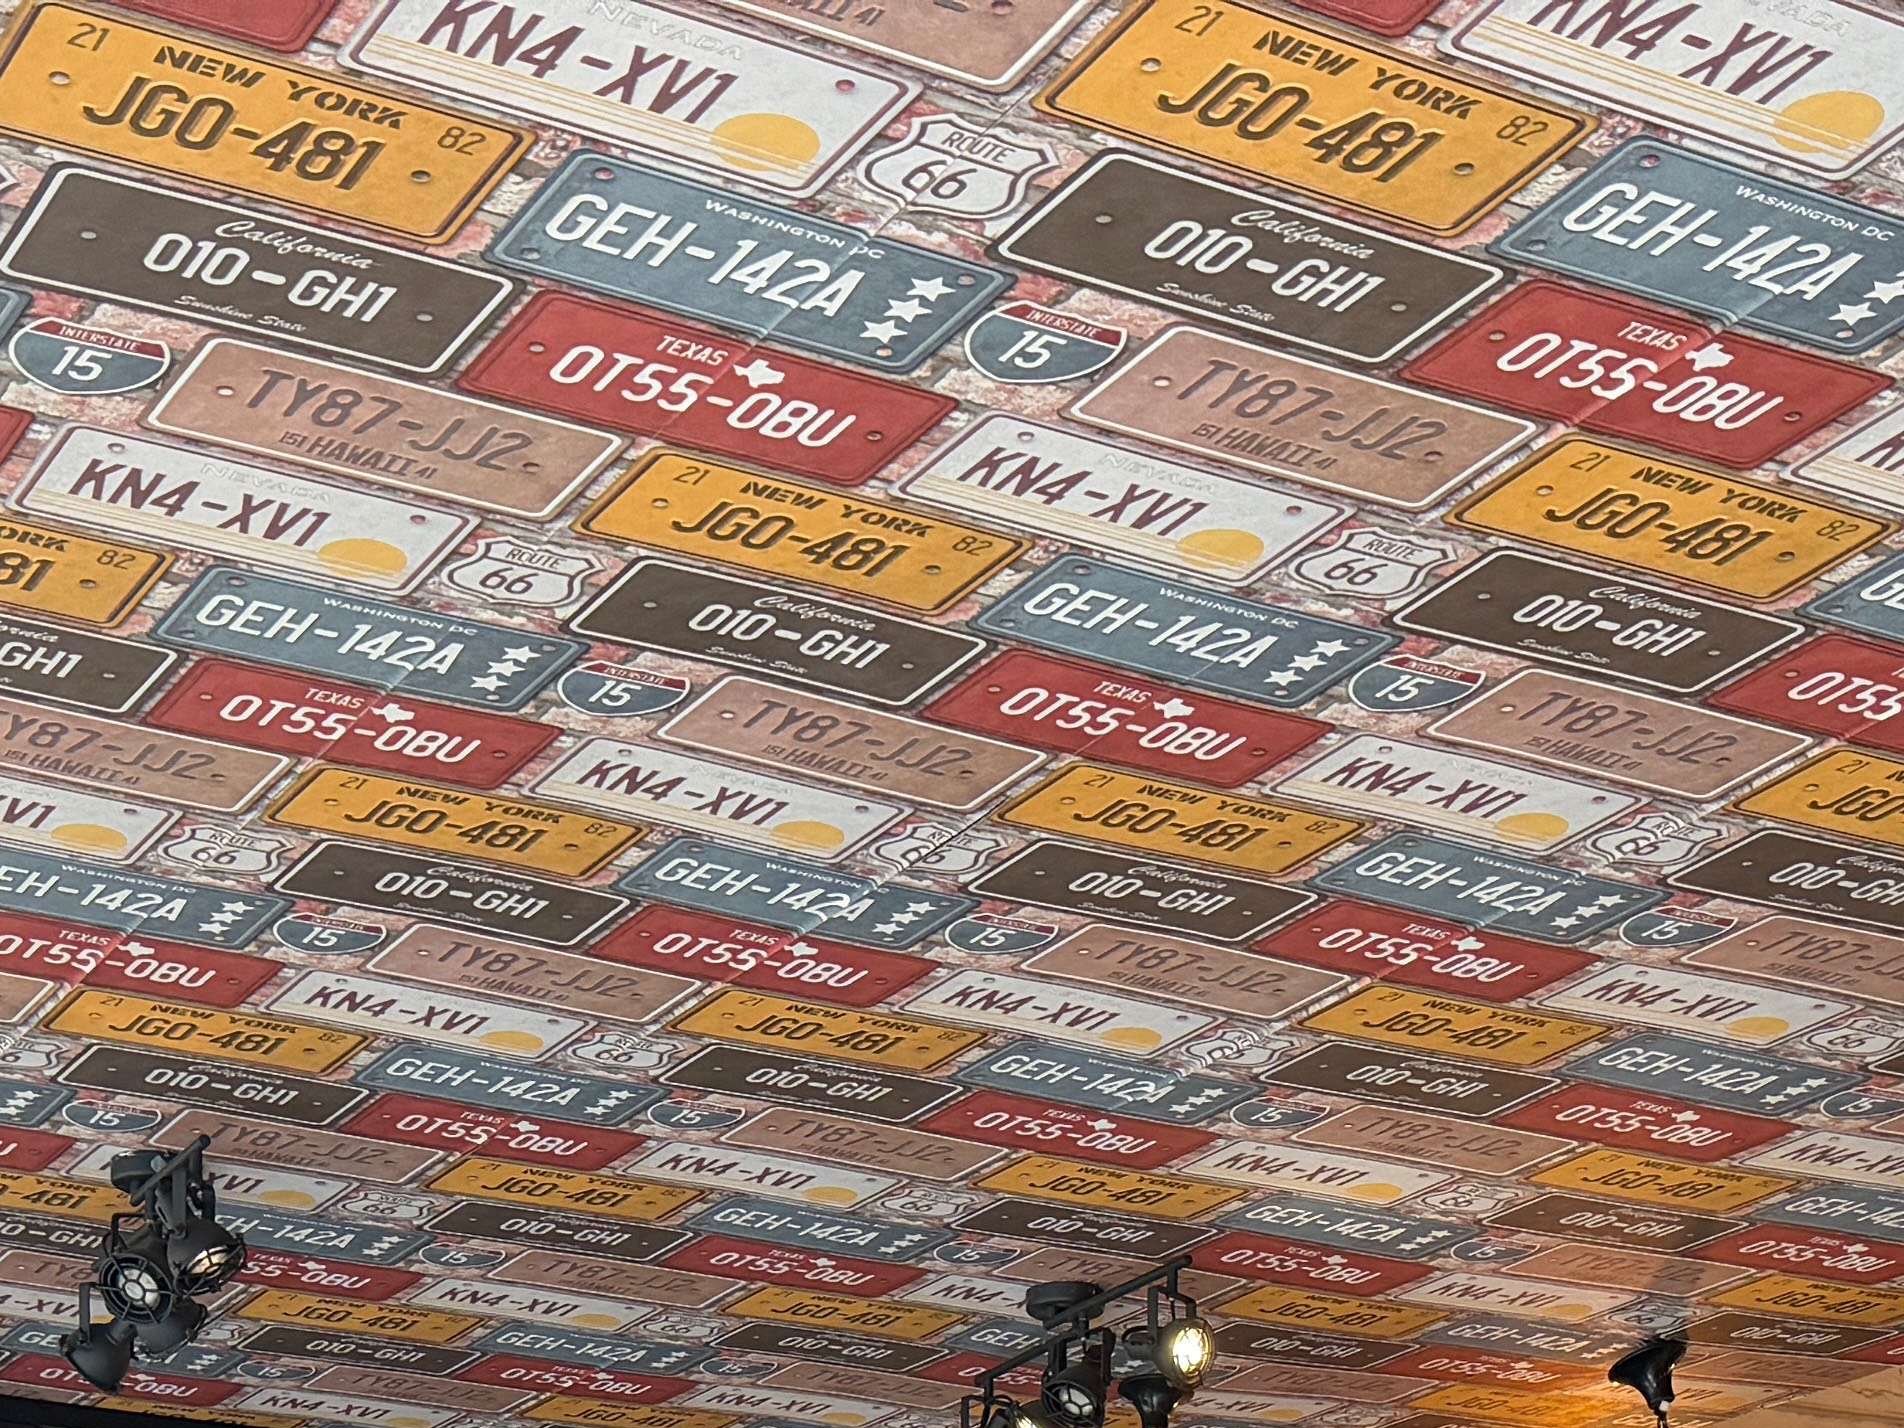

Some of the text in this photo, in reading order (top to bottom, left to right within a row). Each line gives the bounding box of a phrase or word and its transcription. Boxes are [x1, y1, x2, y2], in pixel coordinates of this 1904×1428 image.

[66, 23, 108, 51] 21
[1174, 12, 1223, 40] 21
[153, 45, 406, 120] NEW YORK
[1253, 34, 1481, 110] NEW YORK
[437, 124, 486, 155] 82
[942, 131, 1018, 156] ROUTE
[1496, 114, 1549, 145] 82
[912, 162, 975, 199] 66
[1736, 184, 1854, 231] WASHINGTON
[216, 223, 372, 266] California
[544, 195, 860, 312] GEH-142A
[1230, 212, 1372, 256] California
[1562, 179, 1856, 298] GEH-142A
[658, 335, 727, 362] TEXAS
[999, 331, 1065, 366] 15
[1620, 318, 1686, 345] TEXAS
[53, 345, 110, 380] 15
[741, 479, 935, 530] NEW YORK
[195, 592, 460, 672] GEH-142A
[1022, 584, 1272, 665] GEH-142A
